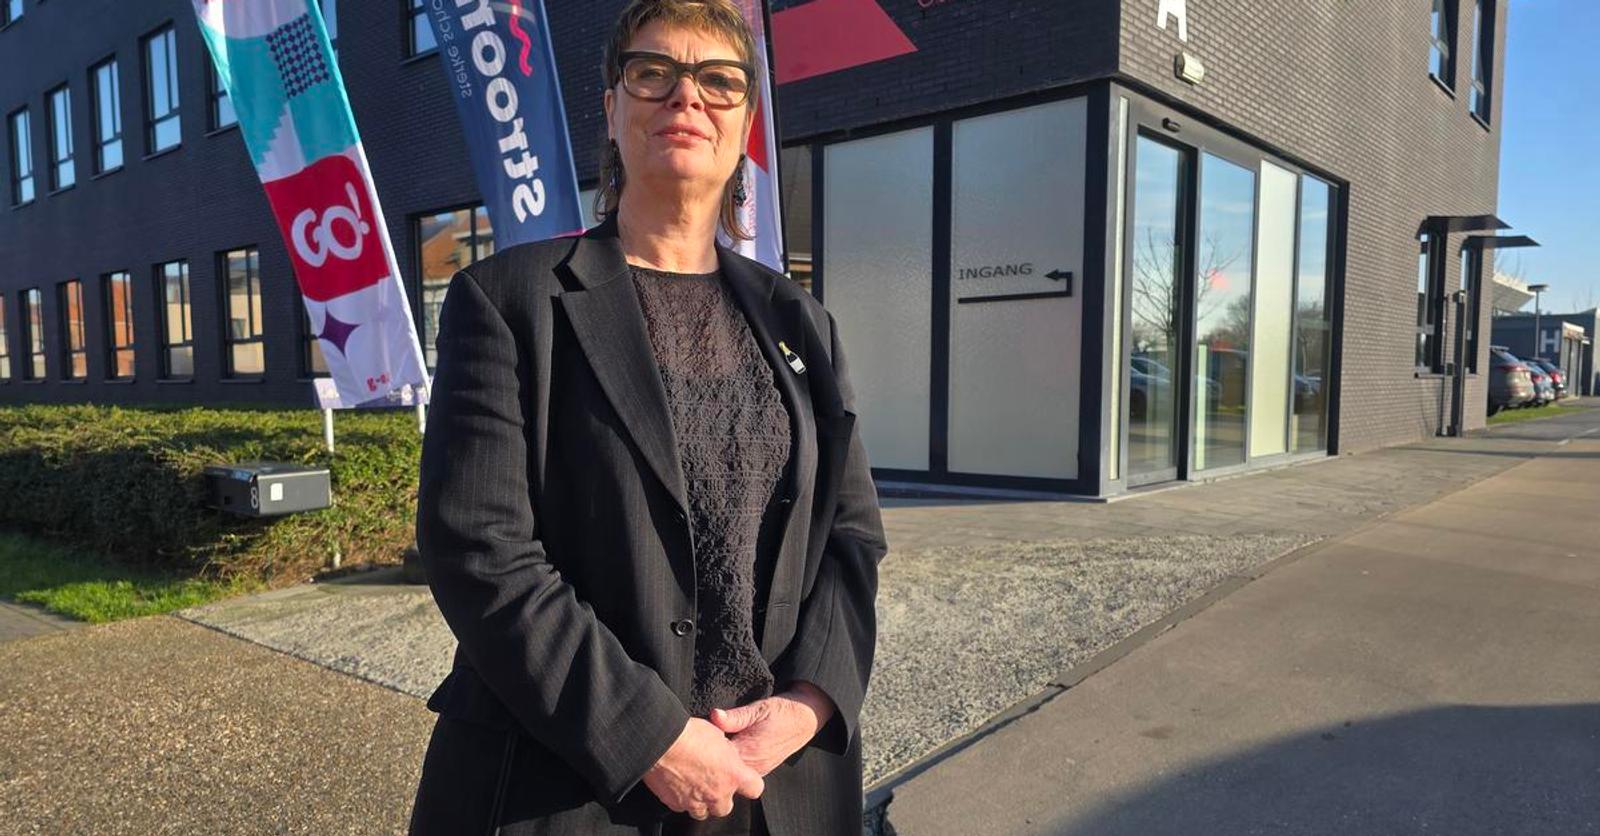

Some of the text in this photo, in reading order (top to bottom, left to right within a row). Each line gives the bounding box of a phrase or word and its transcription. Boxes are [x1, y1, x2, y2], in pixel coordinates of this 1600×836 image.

[291, 181, 370, 268] GO!
[959, 262, 1033, 280] INGANG
[1540, 329, 1561, 353] H
[251, 487, 259, 509] 8
